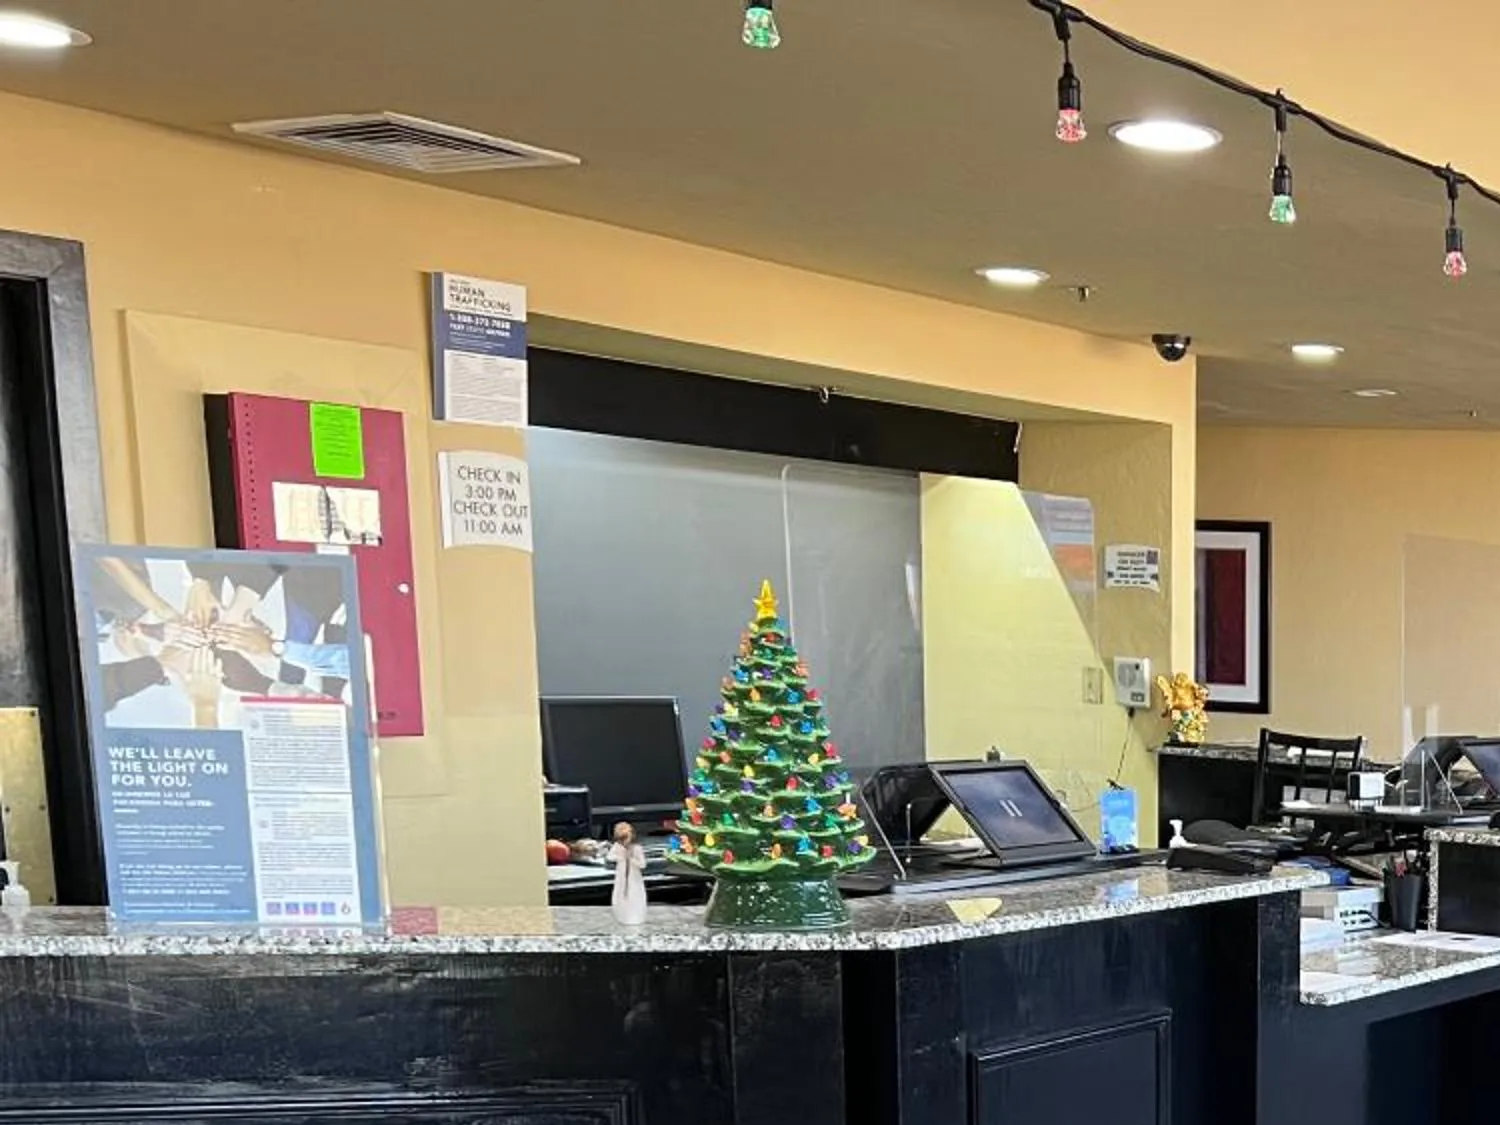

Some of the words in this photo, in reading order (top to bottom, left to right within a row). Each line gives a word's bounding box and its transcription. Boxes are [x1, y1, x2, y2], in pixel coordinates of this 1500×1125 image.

[449, 285, 485, 297] HUMAN
[449, 293, 511, 312] TRAFFICKING
[458, 465, 502, 482] CHECK
[506, 471, 521, 484] IN
[465, 484, 494, 500] 3:00
[497, 487, 516, 501] PM
[454, 499, 497, 516] CHECK
[502, 503, 528, 518] OUT
[464, 519, 497, 534] 11:00
[501, 521, 523, 537] AM
[108, 746, 160, 759] WE'LL
[163, 747, 217, 761] LEAVE
[110, 761, 143, 773] THE
[147, 761, 196, 774] LIGHT
[200, 762, 229, 775] ON
[111, 774, 145, 786] FOR
[150, 775, 193, 787] YOU.
